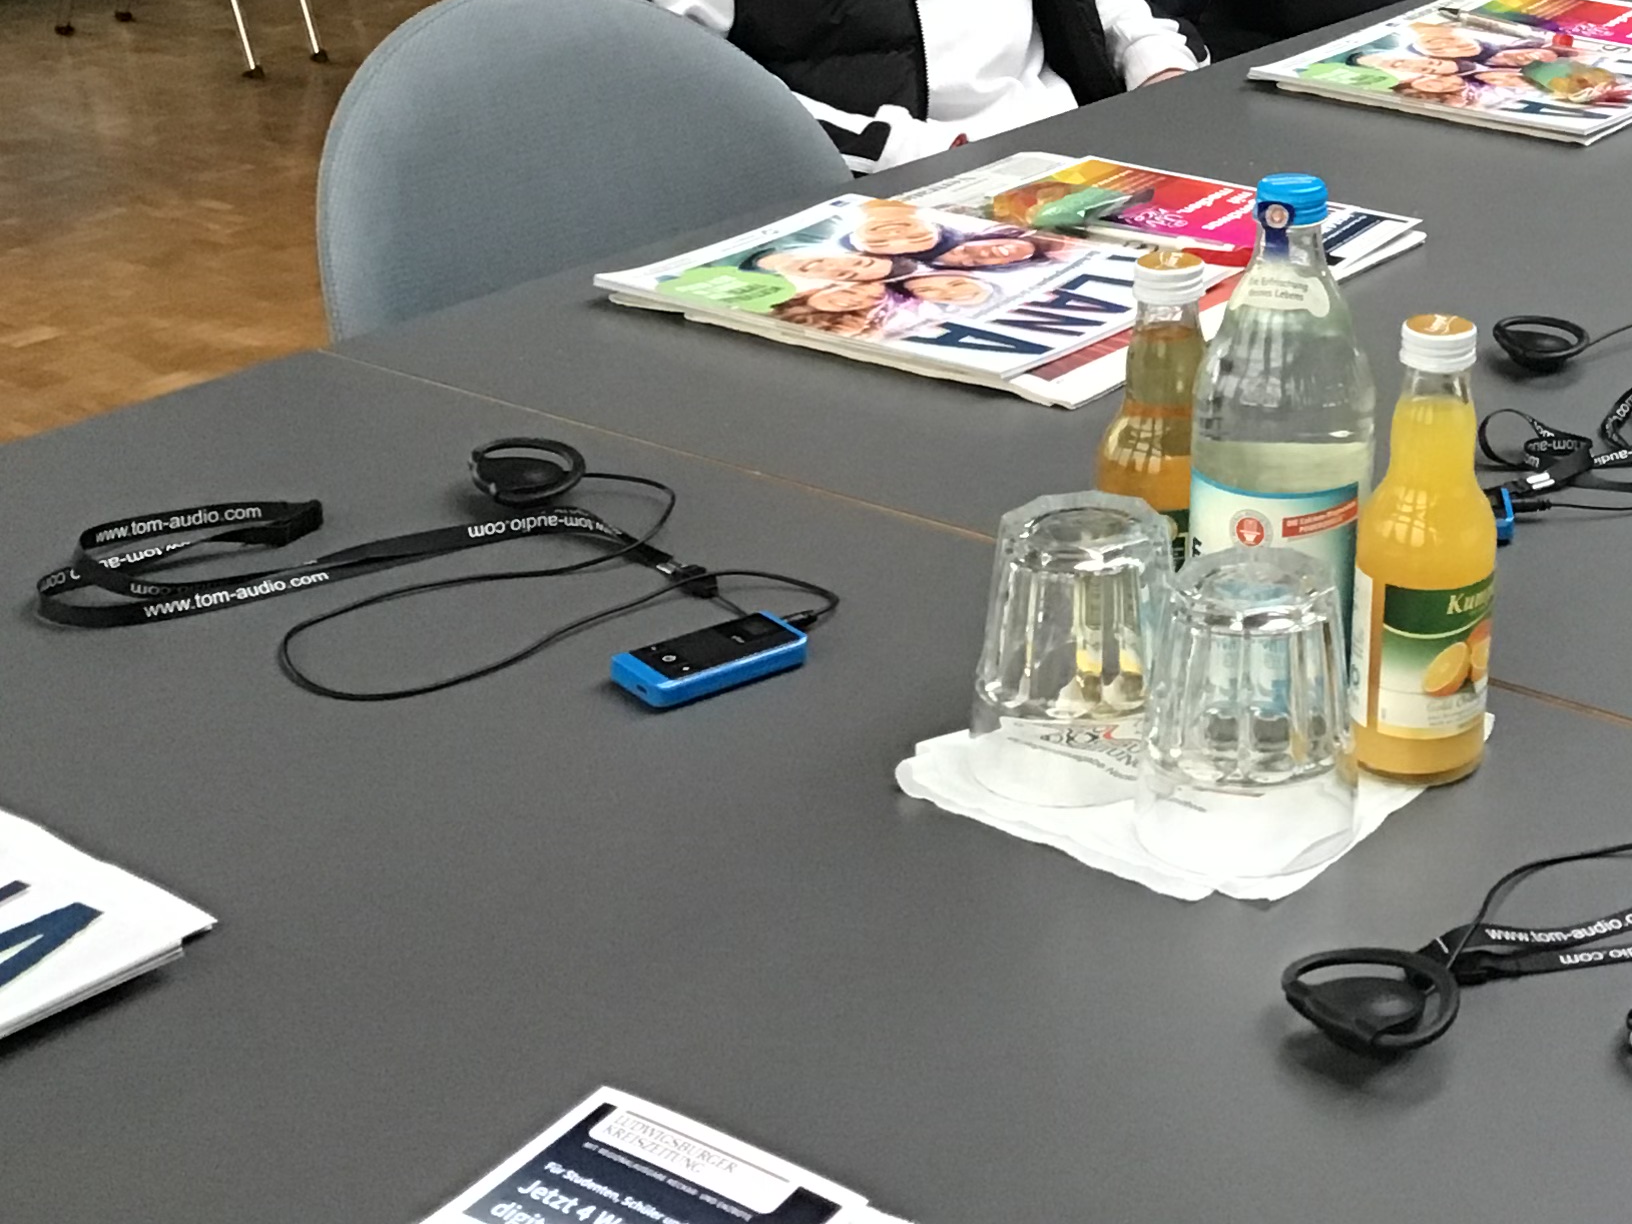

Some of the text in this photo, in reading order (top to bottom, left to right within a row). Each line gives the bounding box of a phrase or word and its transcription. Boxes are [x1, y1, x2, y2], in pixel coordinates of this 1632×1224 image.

[95, 505, 263, 544] www.tom-audio.com
[143, 569, 330, 618] www.tom-audio.com
[612, 1113, 739, 1175] LUDWIGSBURGER
[517, 1179, 579, 1215] Jetzt
[575, 1204, 597, 1222] 4
[562, 1169, 621, 1204] Studenten,
